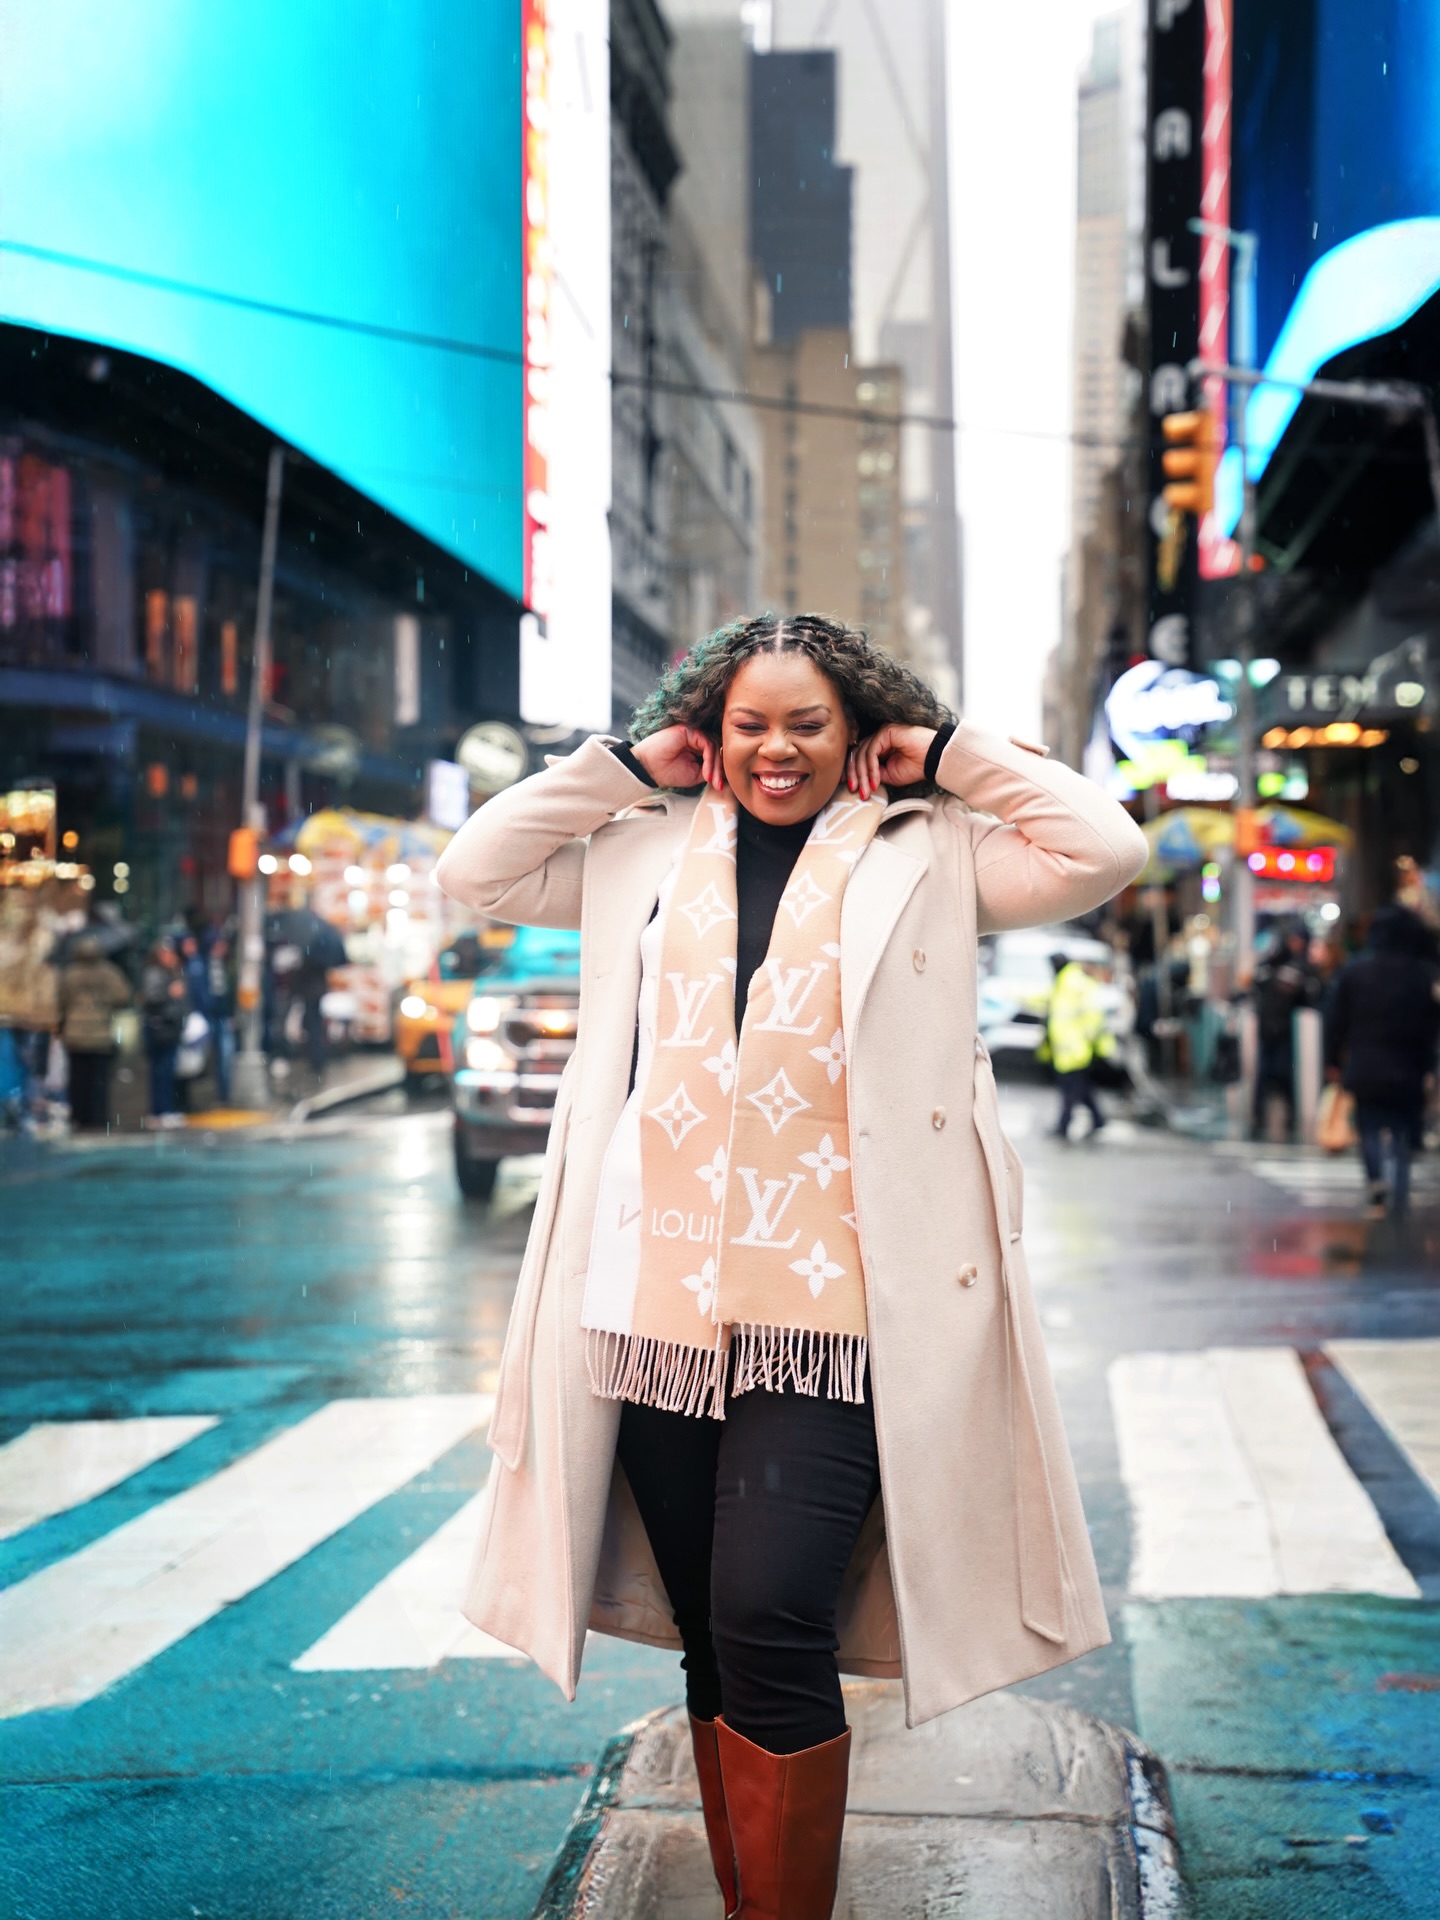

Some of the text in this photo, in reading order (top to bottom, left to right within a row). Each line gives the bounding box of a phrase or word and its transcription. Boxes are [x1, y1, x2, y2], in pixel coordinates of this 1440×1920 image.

[660, 972, 725, 1047] LV
[752, 957, 829, 1036] LV
[651, 1207, 719, 1244] LOUI
[730, 1166, 807, 1250] LV
